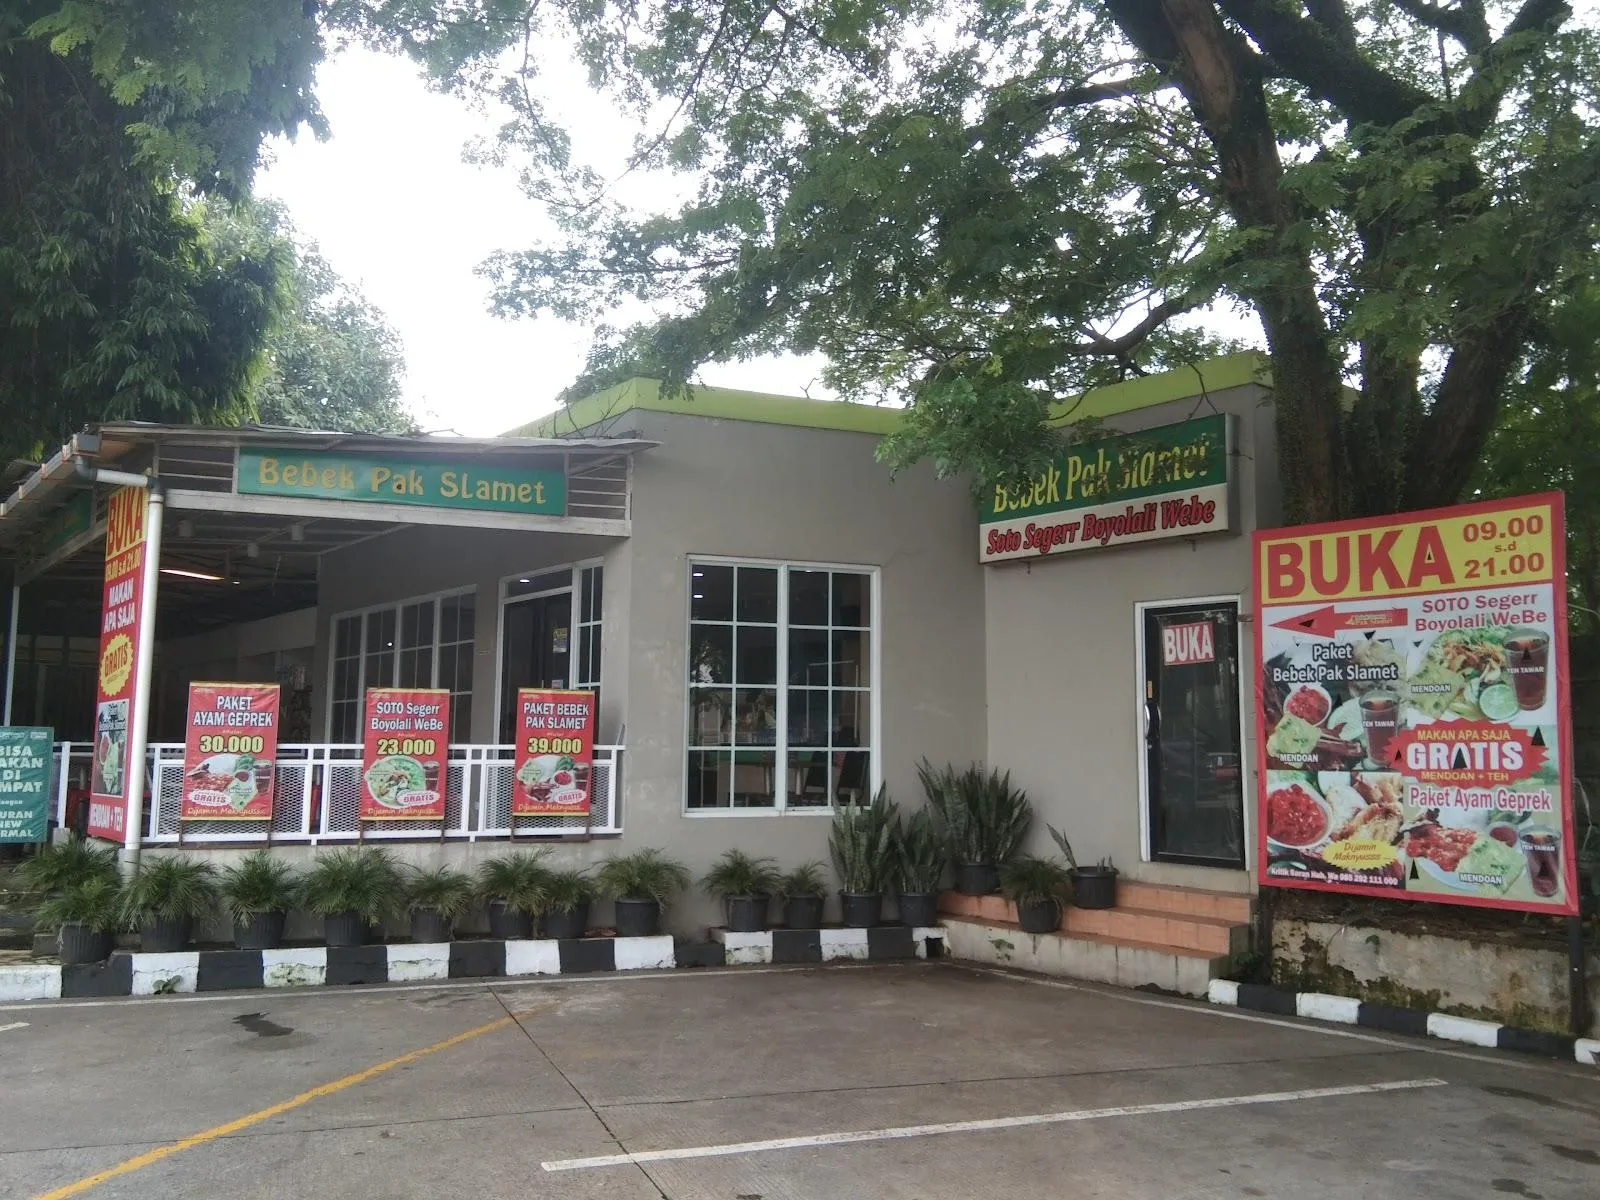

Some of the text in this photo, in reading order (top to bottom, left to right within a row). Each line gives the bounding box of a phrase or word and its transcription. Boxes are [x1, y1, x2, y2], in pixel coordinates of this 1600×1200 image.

[258, 457, 355, 490] Bebek
[371, 465, 424, 497] Pak
[1065, 448, 1111, 500] Pak
[108, 486, 144, 557] BUKA
[987, 495, 1216, 556] Soto Segerr Boyolali Webe
[1462, 515, 1544, 543] 09.00
[1494, 541, 1516, 553] s.d
[1267, 525, 1457, 599] BUKA
[1464, 552, 1544, 579] 21.00
[109, 578, 134, 608] MAKAN
[1422, 593, 1538, 613] SOTO Segerr
[104, 602, 135, 633] APA SAJA
[1415, 609, 1547, 632] Boyolali WeBe
[1164, 624, 1214, 662] BUKA
[104, 641, 128, 677] GRATIS
[1313, 644, 1353, 660] Paket
[1273, 664, 1397, 682] Bebek Pak Slamet
[1411, 685, 1450, 693] MENDOAN
[217, 696, 252, 710] PAKET
[376, 702, 439, 717] SOTO Segerr
[524, 703, 589, 715] PAKET BEBEK
[193, 711, 272, 726] AYAM GEPREK
[371, 718, 443, 732] Boyolali WeBe
[526, 717, 586, 729] PAK SLAMET
[1417, 729, 1511, 740] MAKAN APA SAJA
[200, 735, 264, 753] 30.000
[377, 738, 435, 755] 23.000
[528, 737, 582, 754] 39.000
[1280, 753, 1318, 762] MENDOAN
[1407, 741, 1523, 770] GRATIS
[3, 770, 20, 780] DI
[1421, 772, 1475, 780] MENDOAN
[1487, 772, 1508, 781] TEH
[1410, 787, 1550, 813] Paket Ayam Geprek
[1344, 843, 1376, 852] Dijamin
[1460, 873, 1502, 883] MENDOAN
